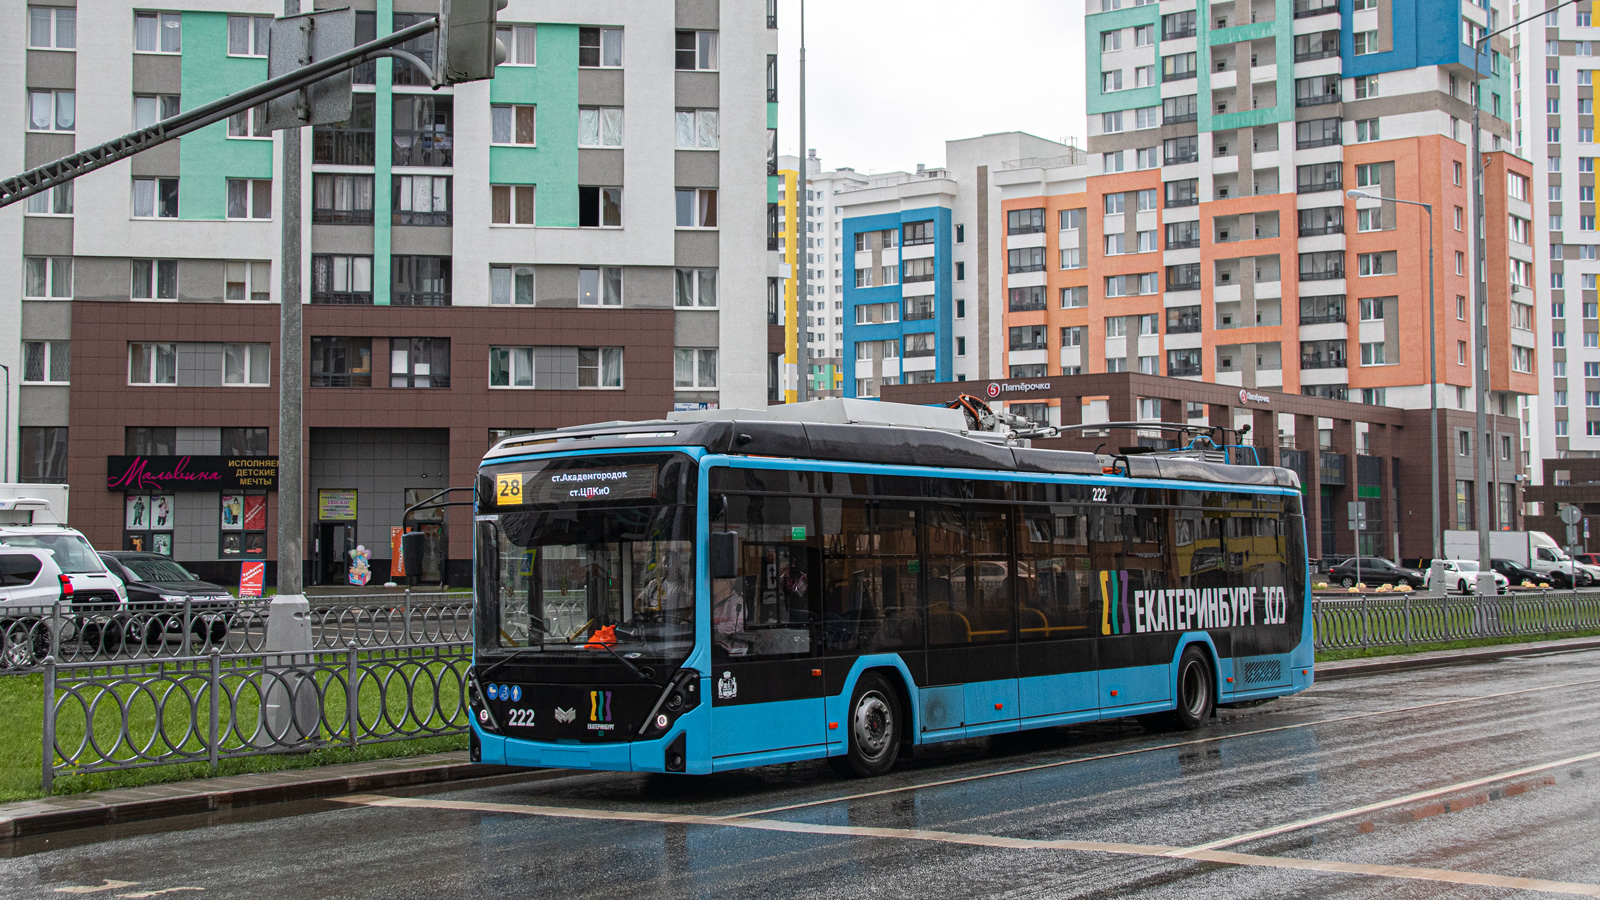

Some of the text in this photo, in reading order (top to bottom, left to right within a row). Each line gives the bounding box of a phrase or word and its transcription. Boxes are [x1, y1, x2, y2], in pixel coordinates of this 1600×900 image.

[1001, 383, 1051, 392] Пятёрочка
[107, 456, 222, 490] Мальвина
[235, 468, 277, 478] ДЕТСКИЕ
[551, 471, 628, 483] ст.Академгородок
[240, 478, 272, 486] МЕЧТЫ
[499, 479, 520, 497] 28
[569, 486, 610, 497] ст.ЦПКиО
[1092, 487, 1107, 501] 222
[1134, 587, 1257, 633] ЕКАТЕРИНБУРГ
[508, 709, 535, 727] 222
